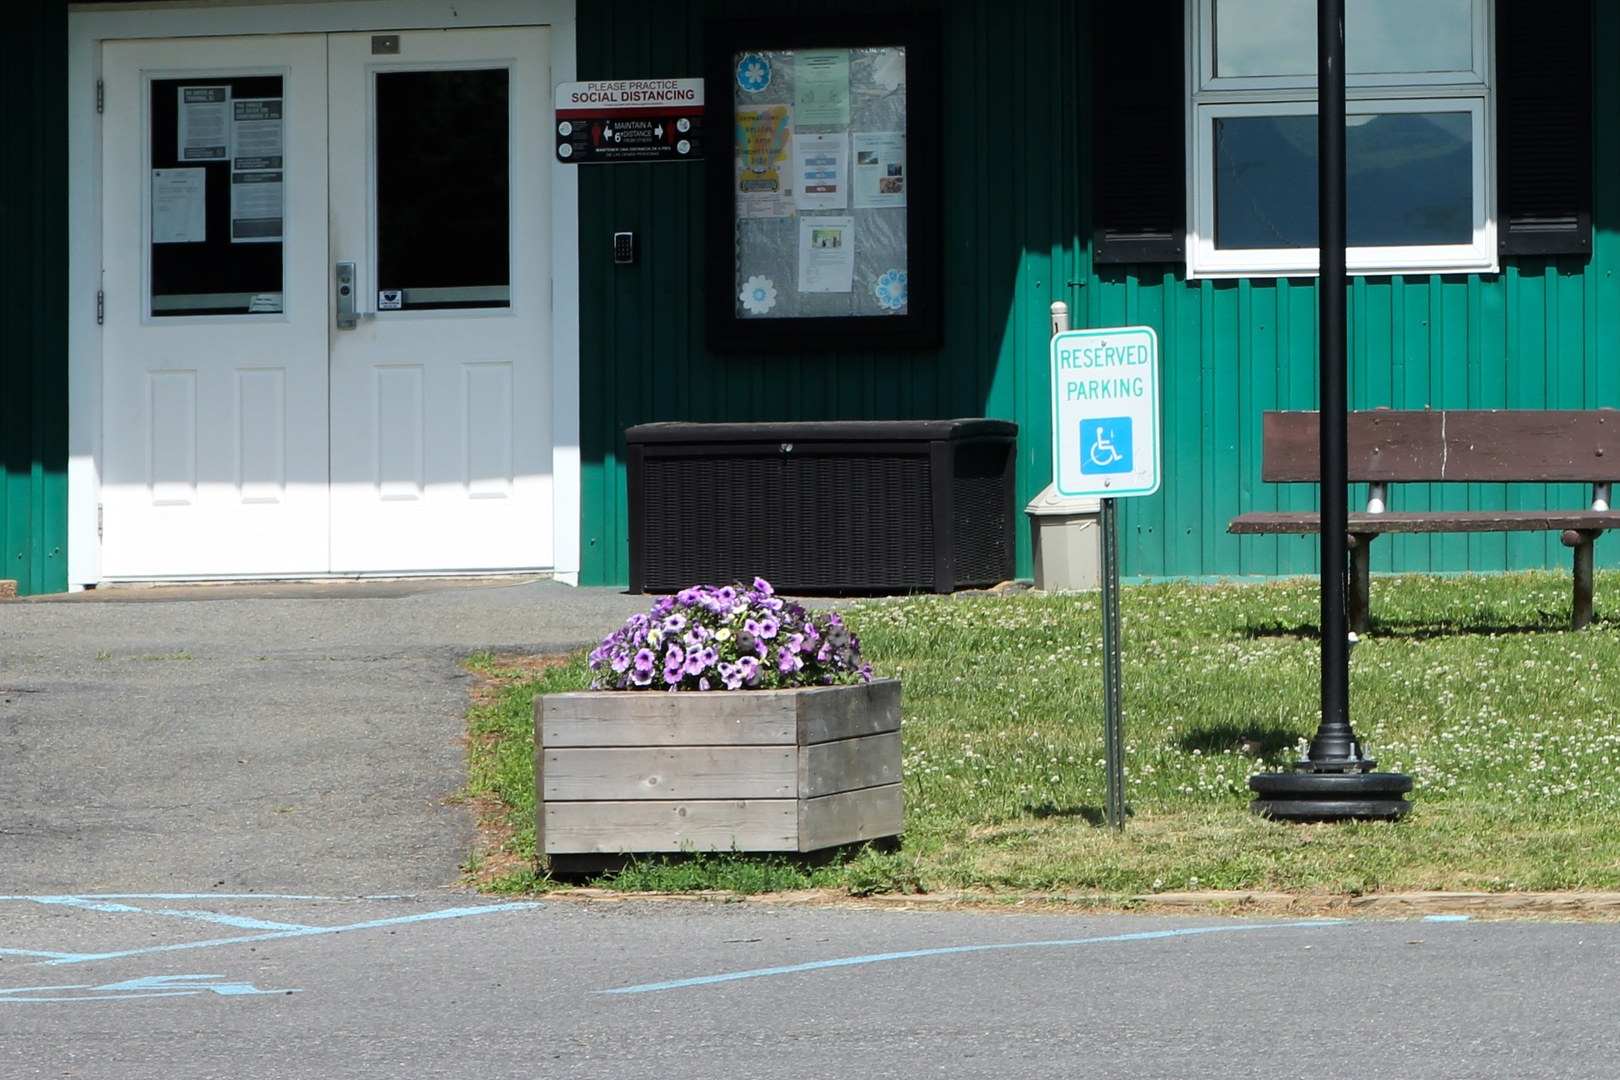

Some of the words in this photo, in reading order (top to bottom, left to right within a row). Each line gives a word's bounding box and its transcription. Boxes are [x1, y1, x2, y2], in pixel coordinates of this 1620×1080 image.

[588, 83, 626, 91] PLEASE
[629, 80, 678, 90] PRACTICE
[571, 92, 617, 103] SOCIAL
[621, 90, 695, 101] DISTANCING
[614, 121, 646, 129] MAINTAIN
[646, 121, 652, 129] A
[624, 130, 652, 138] DISTANCE
[1060, 344, 1148, 369] RESERVED
[1067, 377, 1143, 400] PARKING
